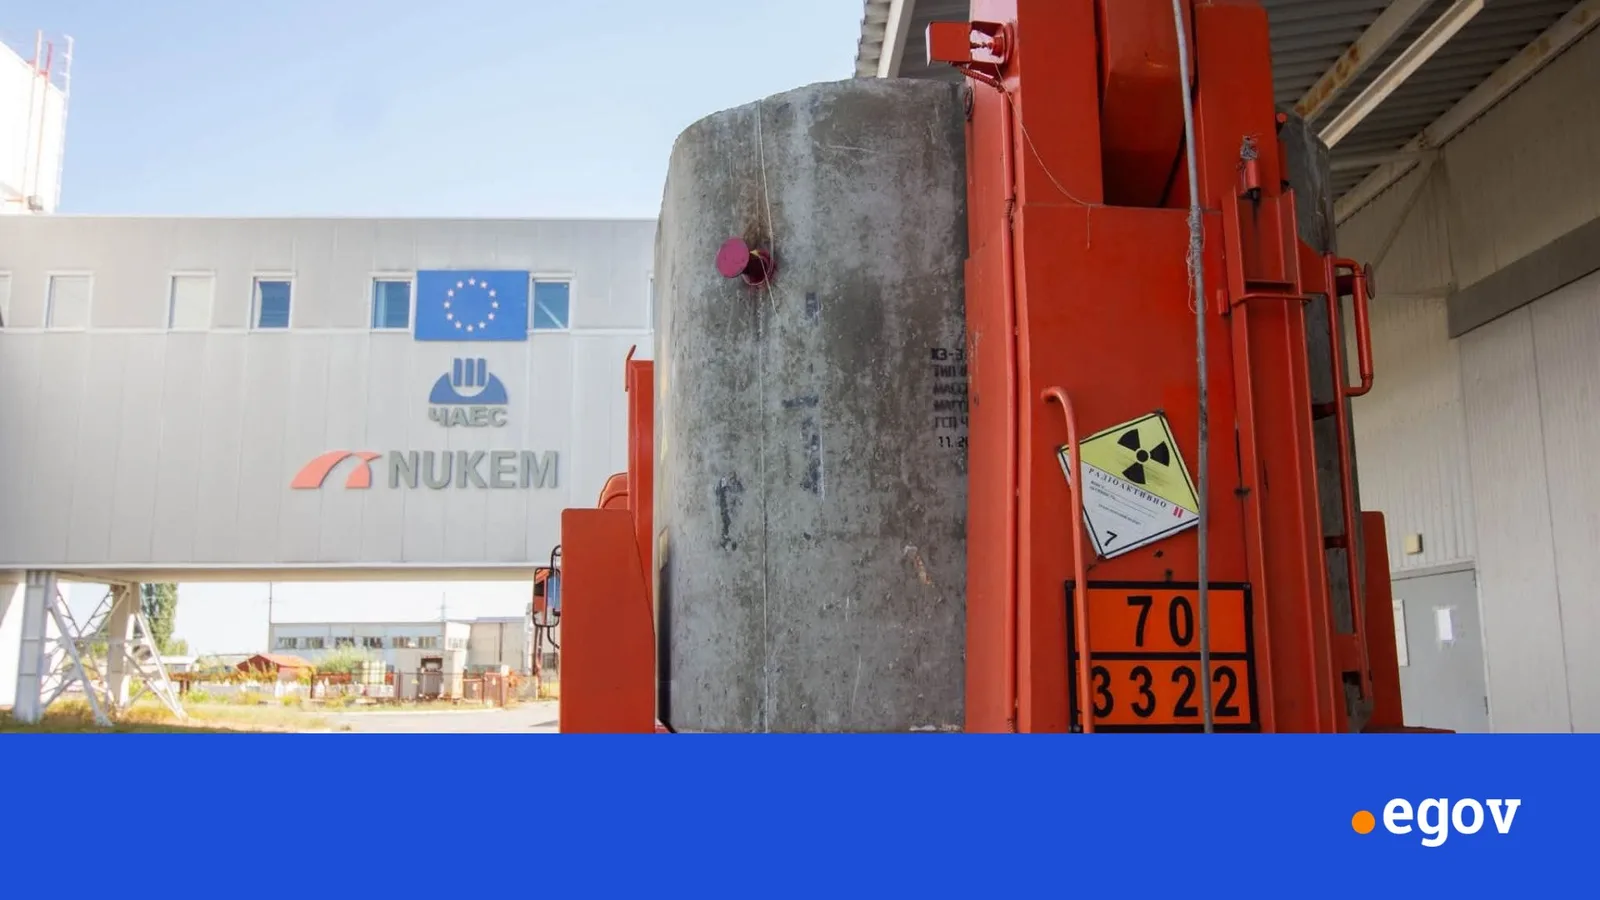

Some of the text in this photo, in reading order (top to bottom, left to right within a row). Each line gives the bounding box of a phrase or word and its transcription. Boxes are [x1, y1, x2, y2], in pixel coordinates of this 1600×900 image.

[428, 406, 508, 428] ЧАЕС
[388, 450, 560, 490] NUKEM
[1088, 467, 1167, 509] РАДІОАКТИВНО
[1104, 530, 1118, 547] 7
[1126, 595, 1194, 648] 70
[1090, 665, 1240, 719] 3322
